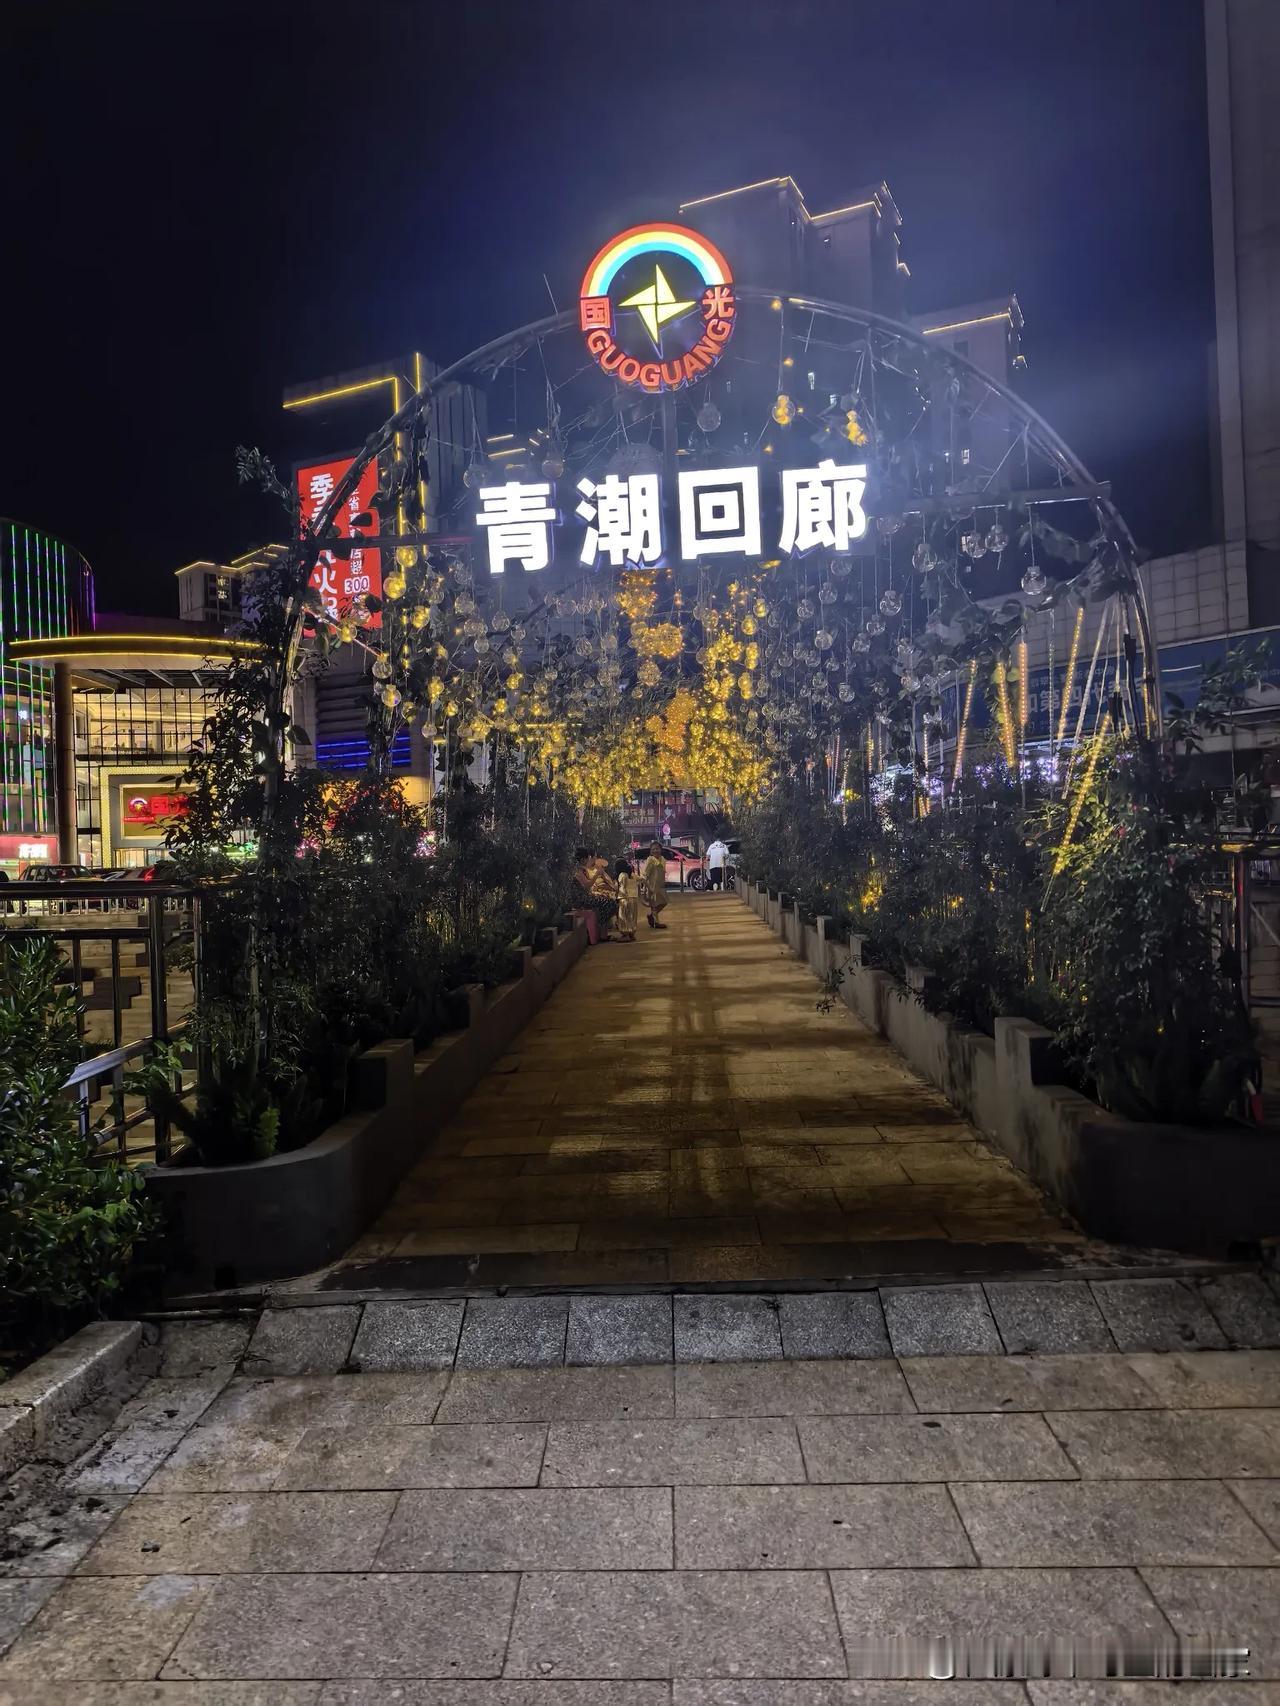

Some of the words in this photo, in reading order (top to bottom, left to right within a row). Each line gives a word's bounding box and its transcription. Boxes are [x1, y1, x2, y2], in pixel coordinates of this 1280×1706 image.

[587, 318, 733, 388] GUOGUANG
[475, 459, 868, 574] 青潮回廊
